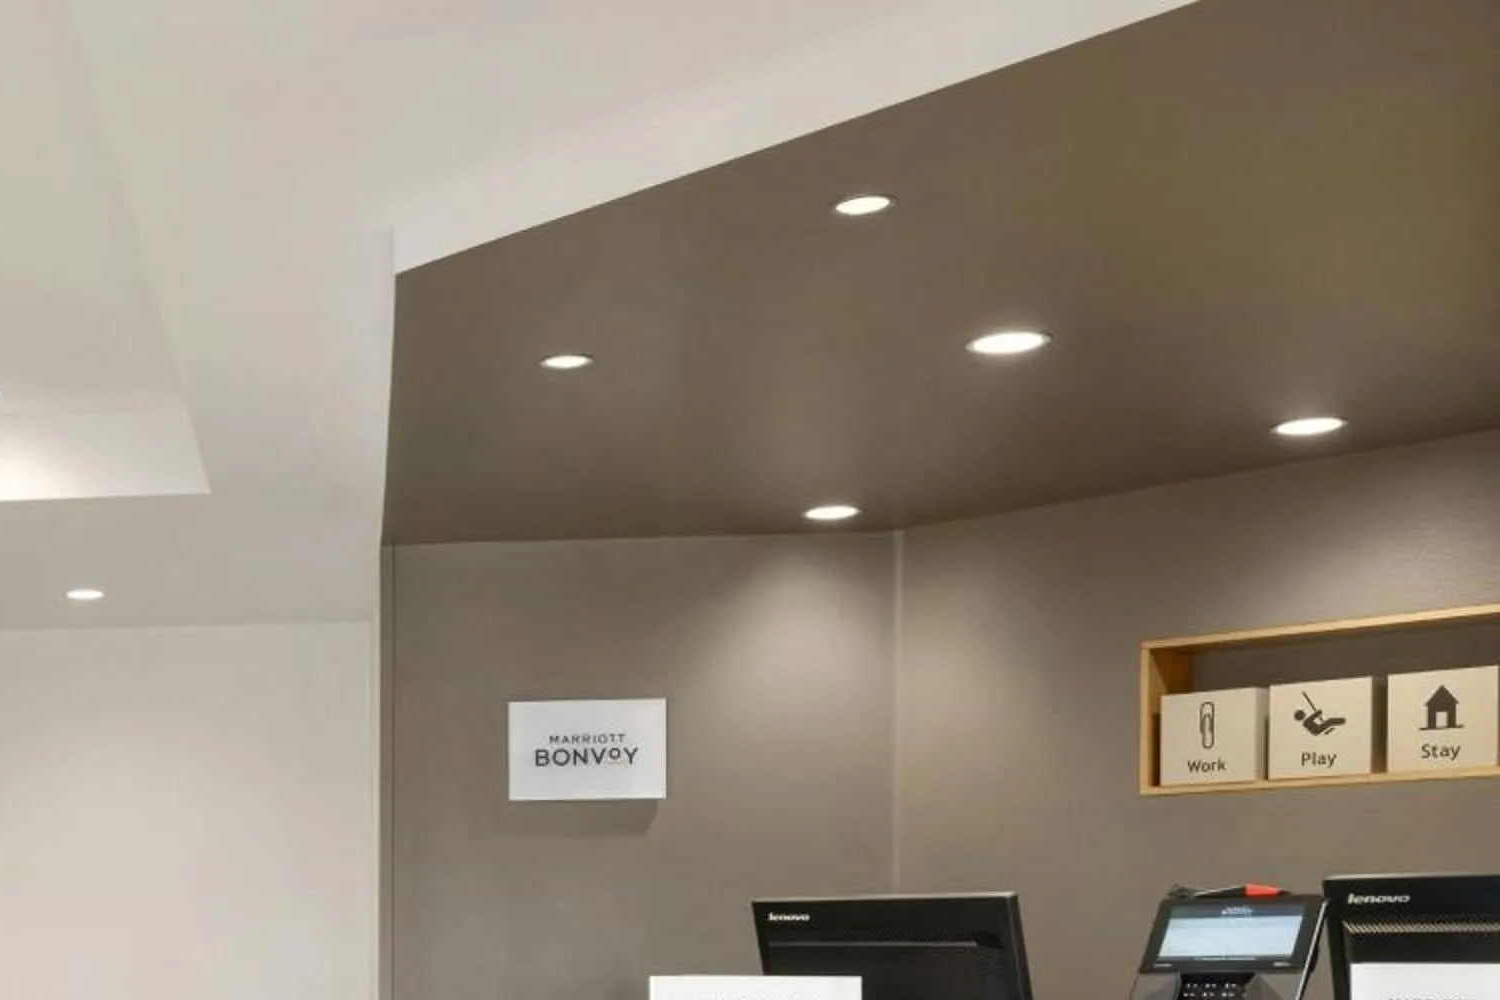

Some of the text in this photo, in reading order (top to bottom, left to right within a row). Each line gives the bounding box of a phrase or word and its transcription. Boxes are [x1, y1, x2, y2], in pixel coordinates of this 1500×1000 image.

[549, 733, 625, 744] MARRIOTT
[1301, 751, 1337, 768] Play
[1420, 743, 1461, 761] Stay
[1187, 758, 1227, 773] Work
[1347, 893, 1411, 904] lenovo
